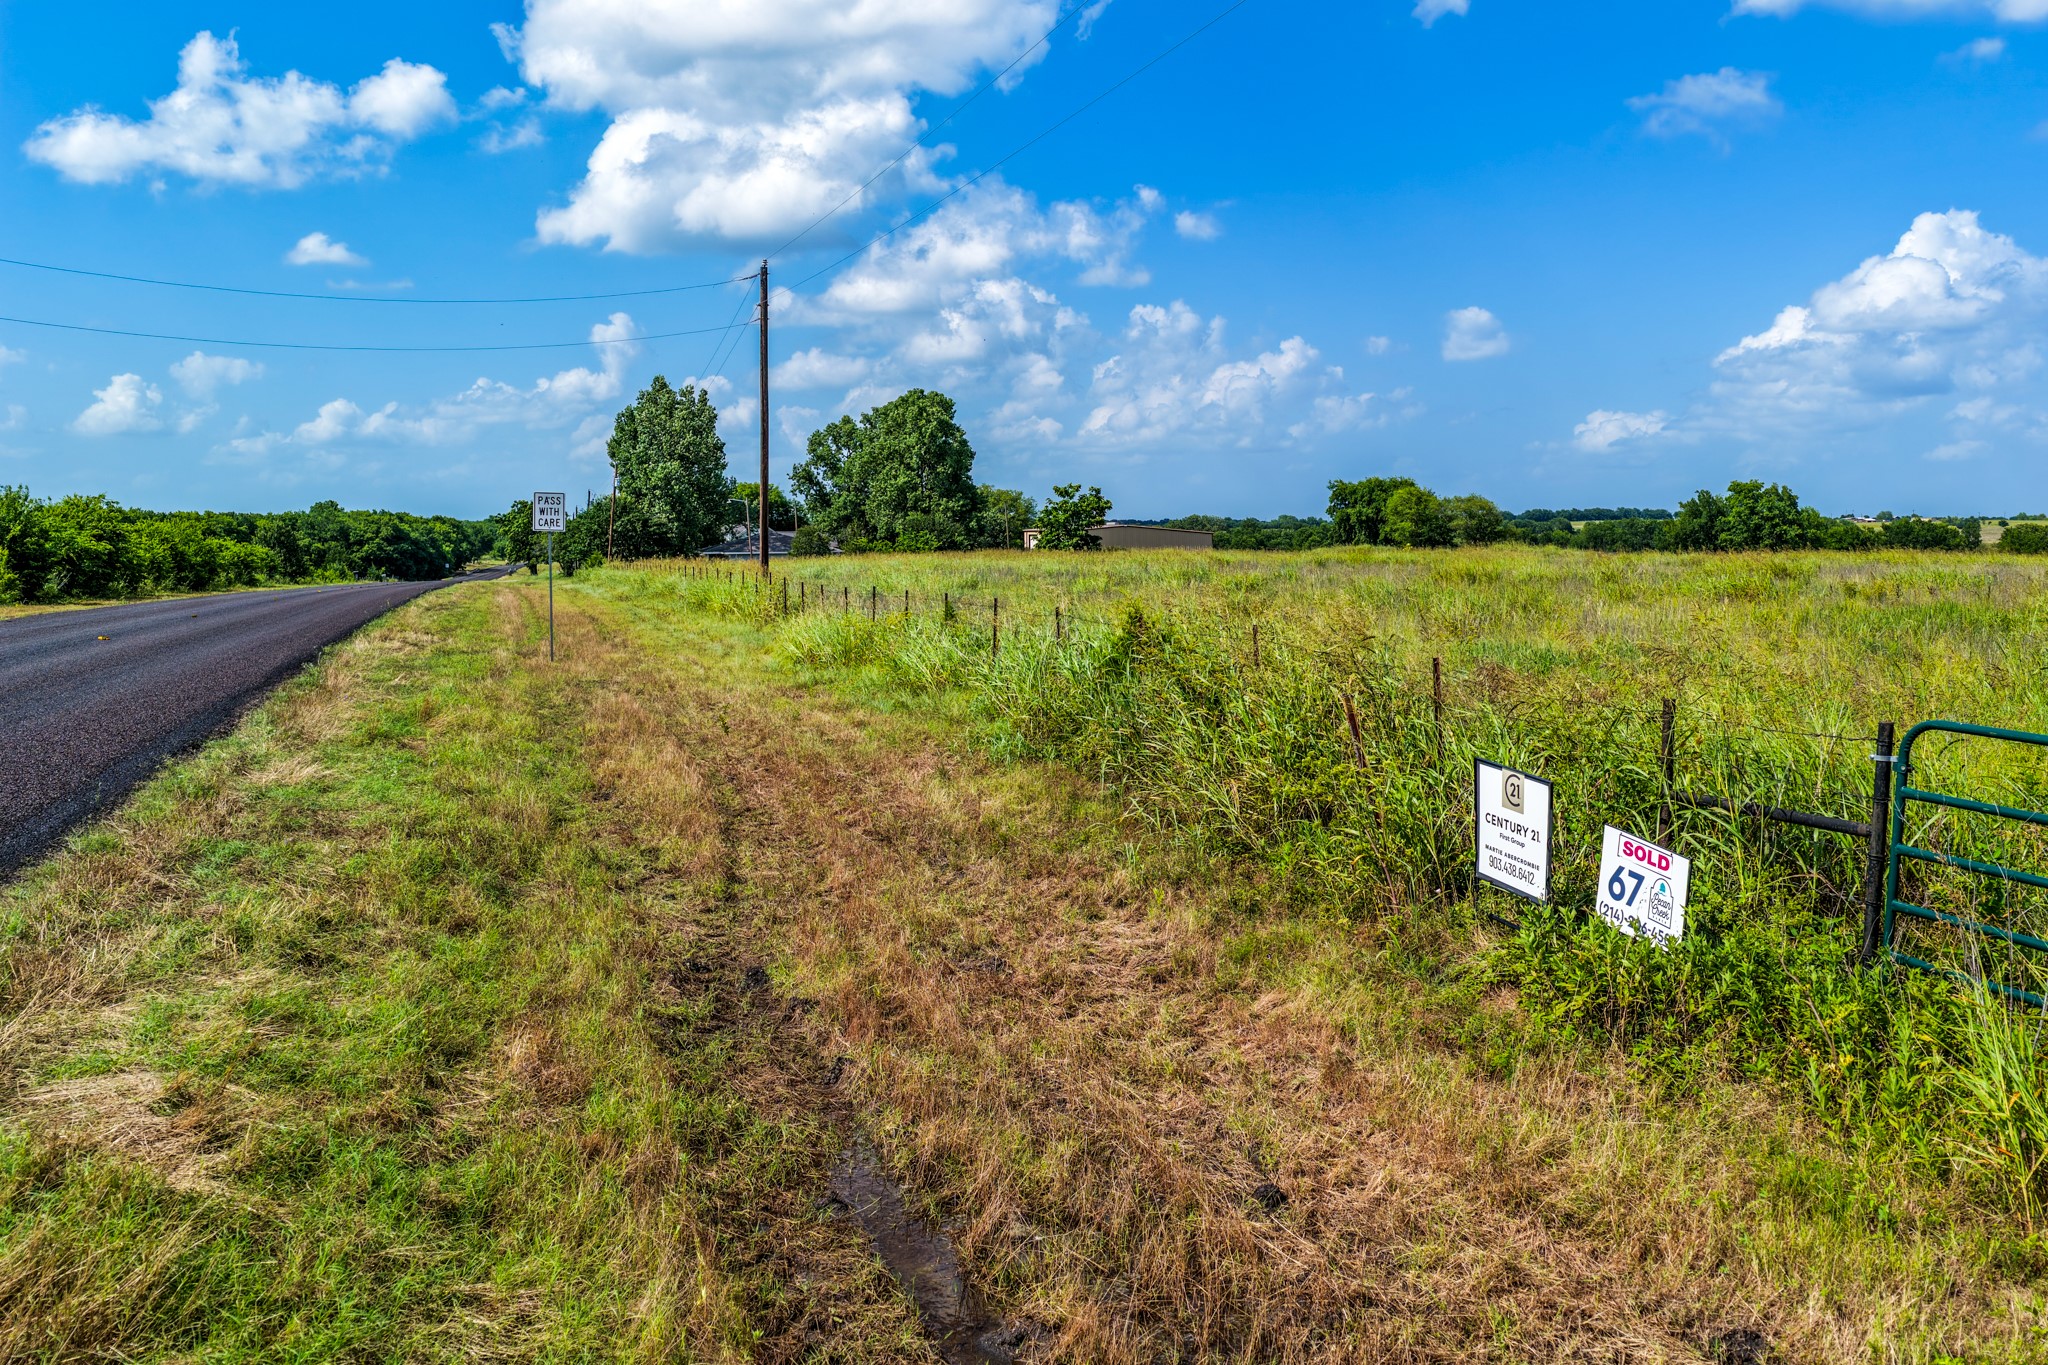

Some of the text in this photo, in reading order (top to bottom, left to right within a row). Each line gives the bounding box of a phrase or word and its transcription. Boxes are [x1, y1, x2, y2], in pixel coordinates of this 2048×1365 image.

[537, 496, 561, 505] PASS
[539, 507, 560, 516] WITH
[538, 518, 561, 527] CARE
[1485, 811, 1529, 838] CENTURY
[1499, 832, 1526, 848] First Group
[1485, 843, 1540, 871] MARTIE ABERCROMBIE
[1622, 840, 1670, 871] SOLD
[1489, 854, 1536, 886] 903.438.6412
[1607, 865, 1646, 907] 67
